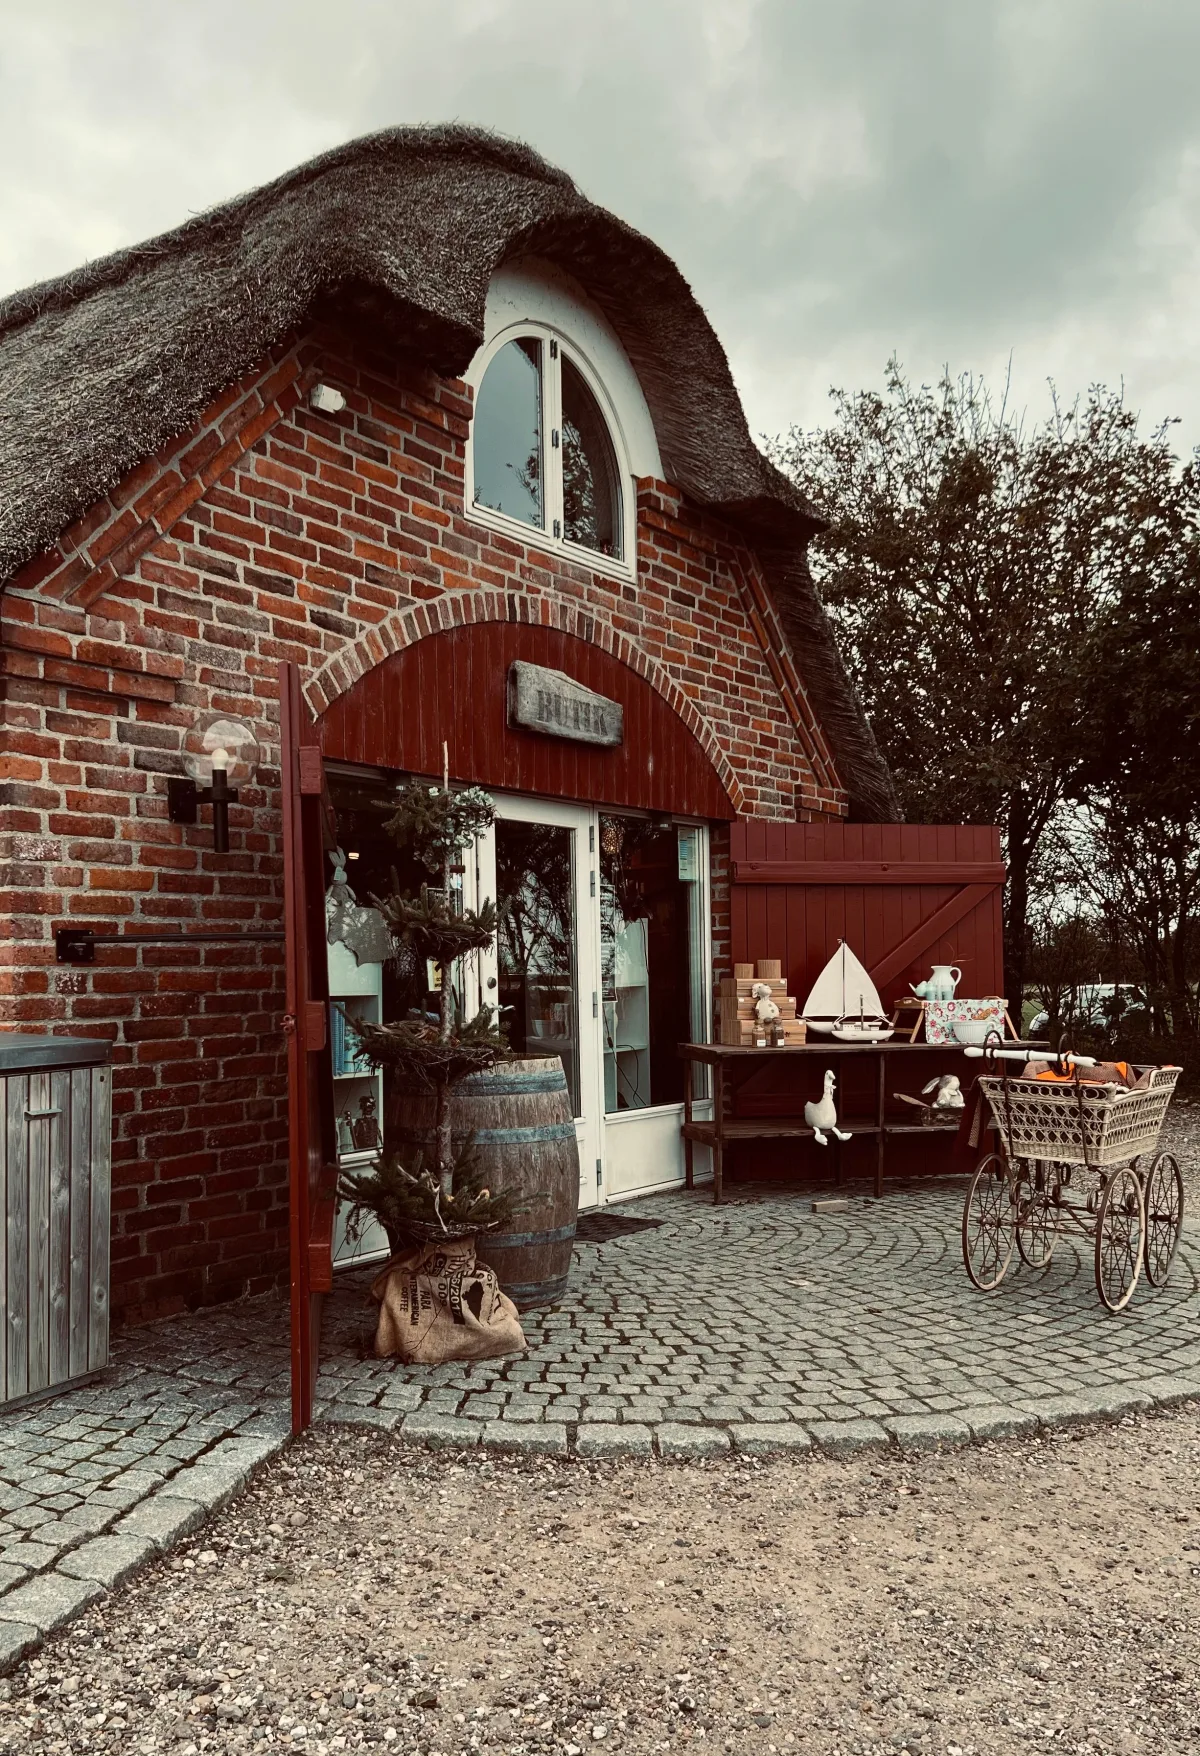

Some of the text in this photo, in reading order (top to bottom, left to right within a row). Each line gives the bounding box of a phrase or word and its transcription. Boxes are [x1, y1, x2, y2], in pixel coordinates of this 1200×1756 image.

[536, 689, 608, 737] BUTIK
[400, 1286, 409, 1312] COFFEE
[420, 1290, 432, 1310] PARA
